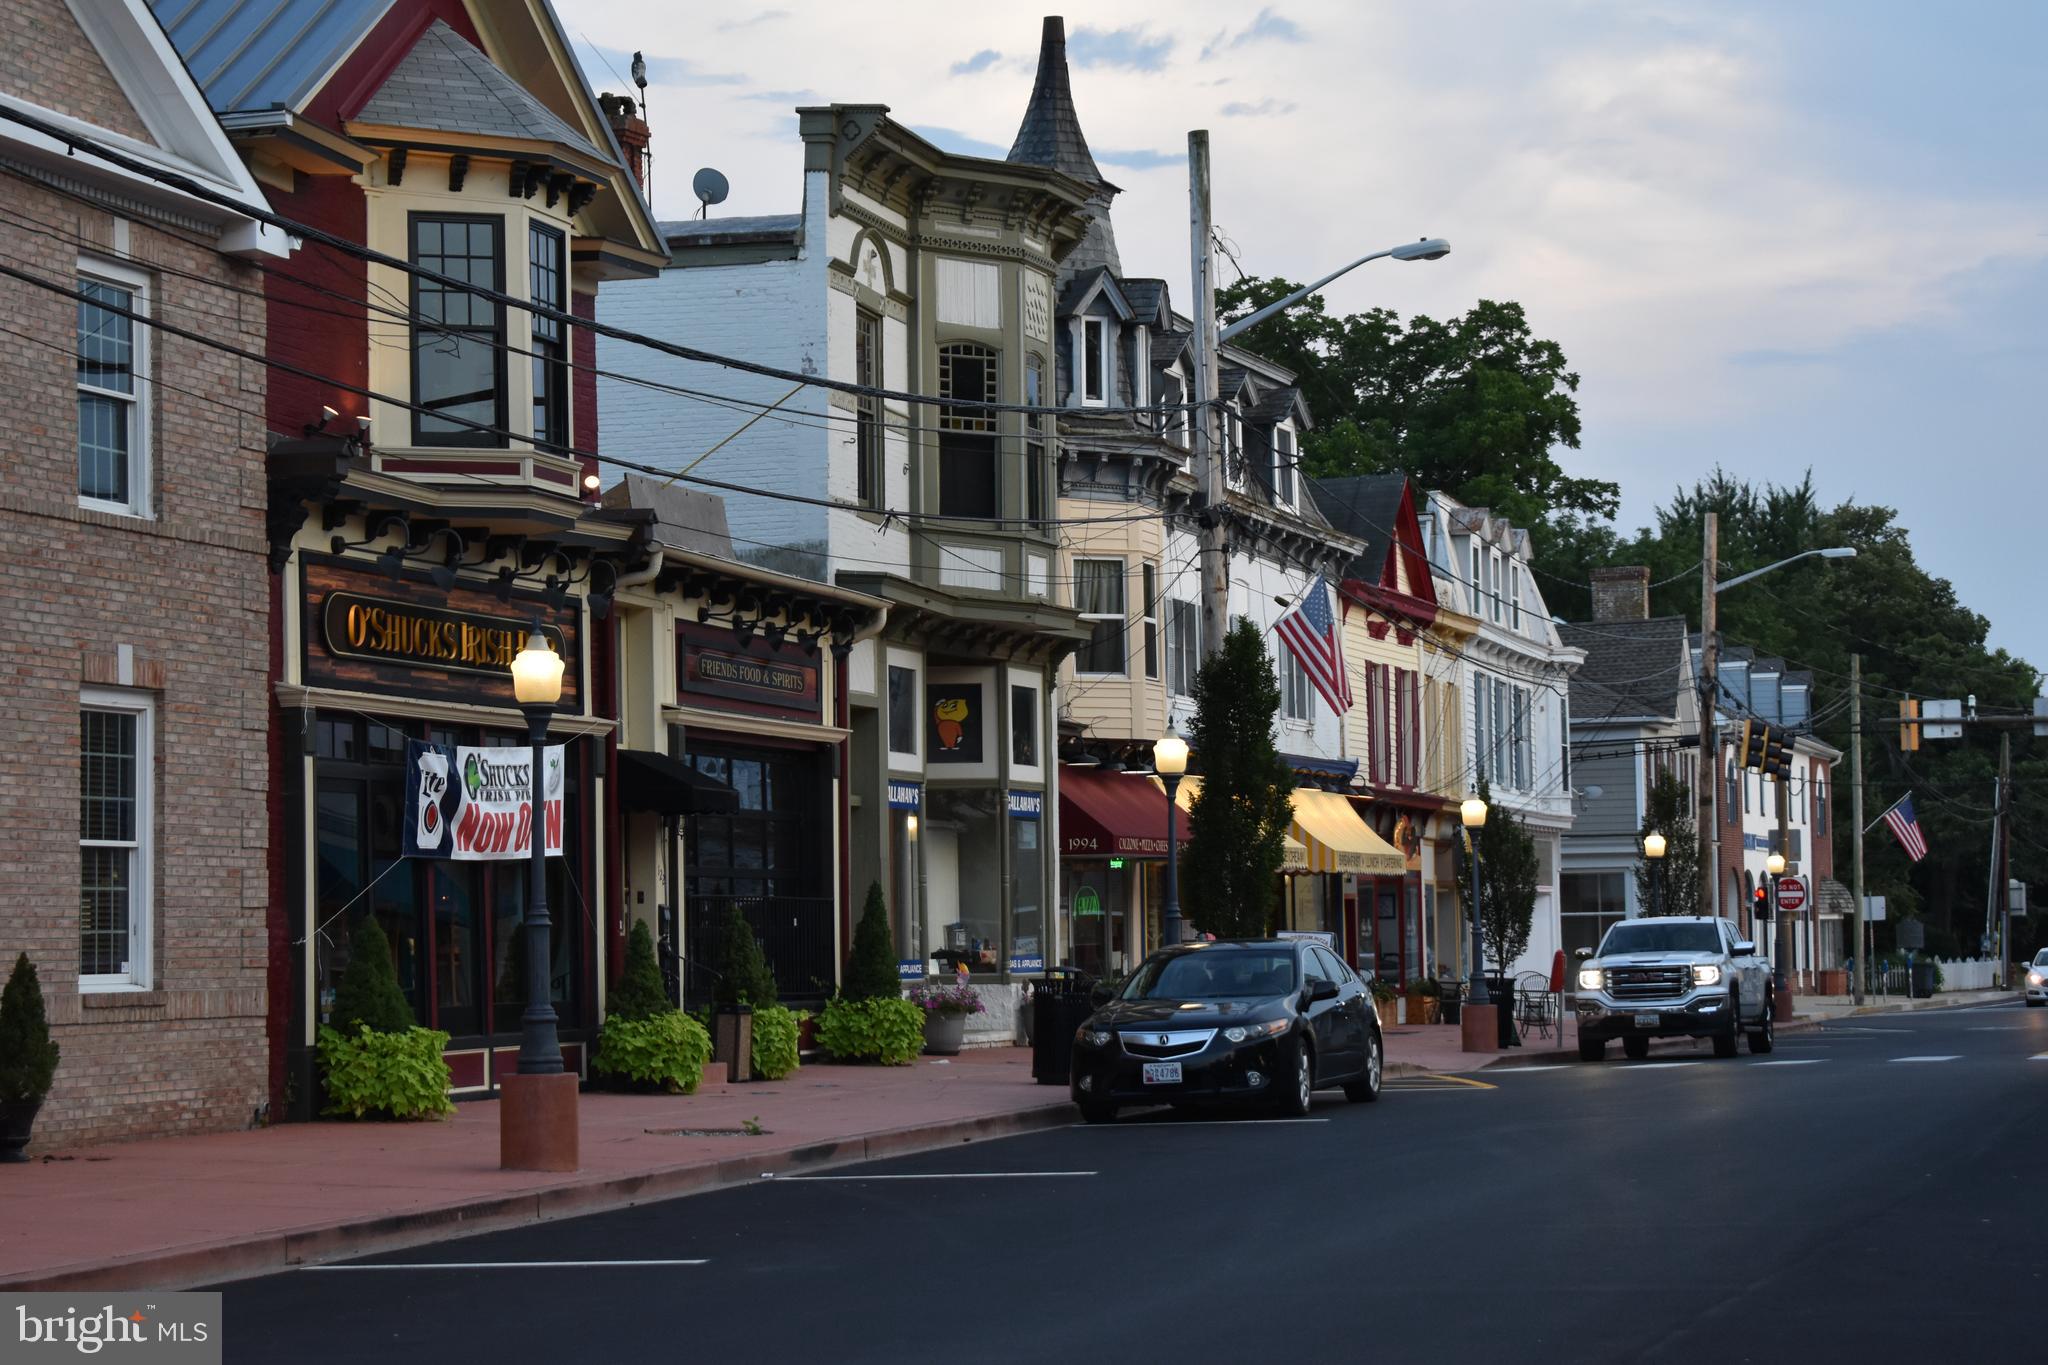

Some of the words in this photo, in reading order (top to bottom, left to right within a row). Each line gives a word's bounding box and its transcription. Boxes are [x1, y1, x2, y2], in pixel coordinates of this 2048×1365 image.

[347, 603, 457, 660] O'SHUCKS
[460, 620, 513, 667] IRISH
[701, 658, 738, 679] FRIENDS
[739, 665, 761, 683] FOOD
[763, 671, 770, 685] &
[771, 671, 804, 690] SPIRITS
[456, 802, 515, 853] NOW
[1069, 838, 1099, 851] 1994
[899, 964, 923, 975] APPLIANCE
[1021, 959, 1043, 969] APPLIANCE
